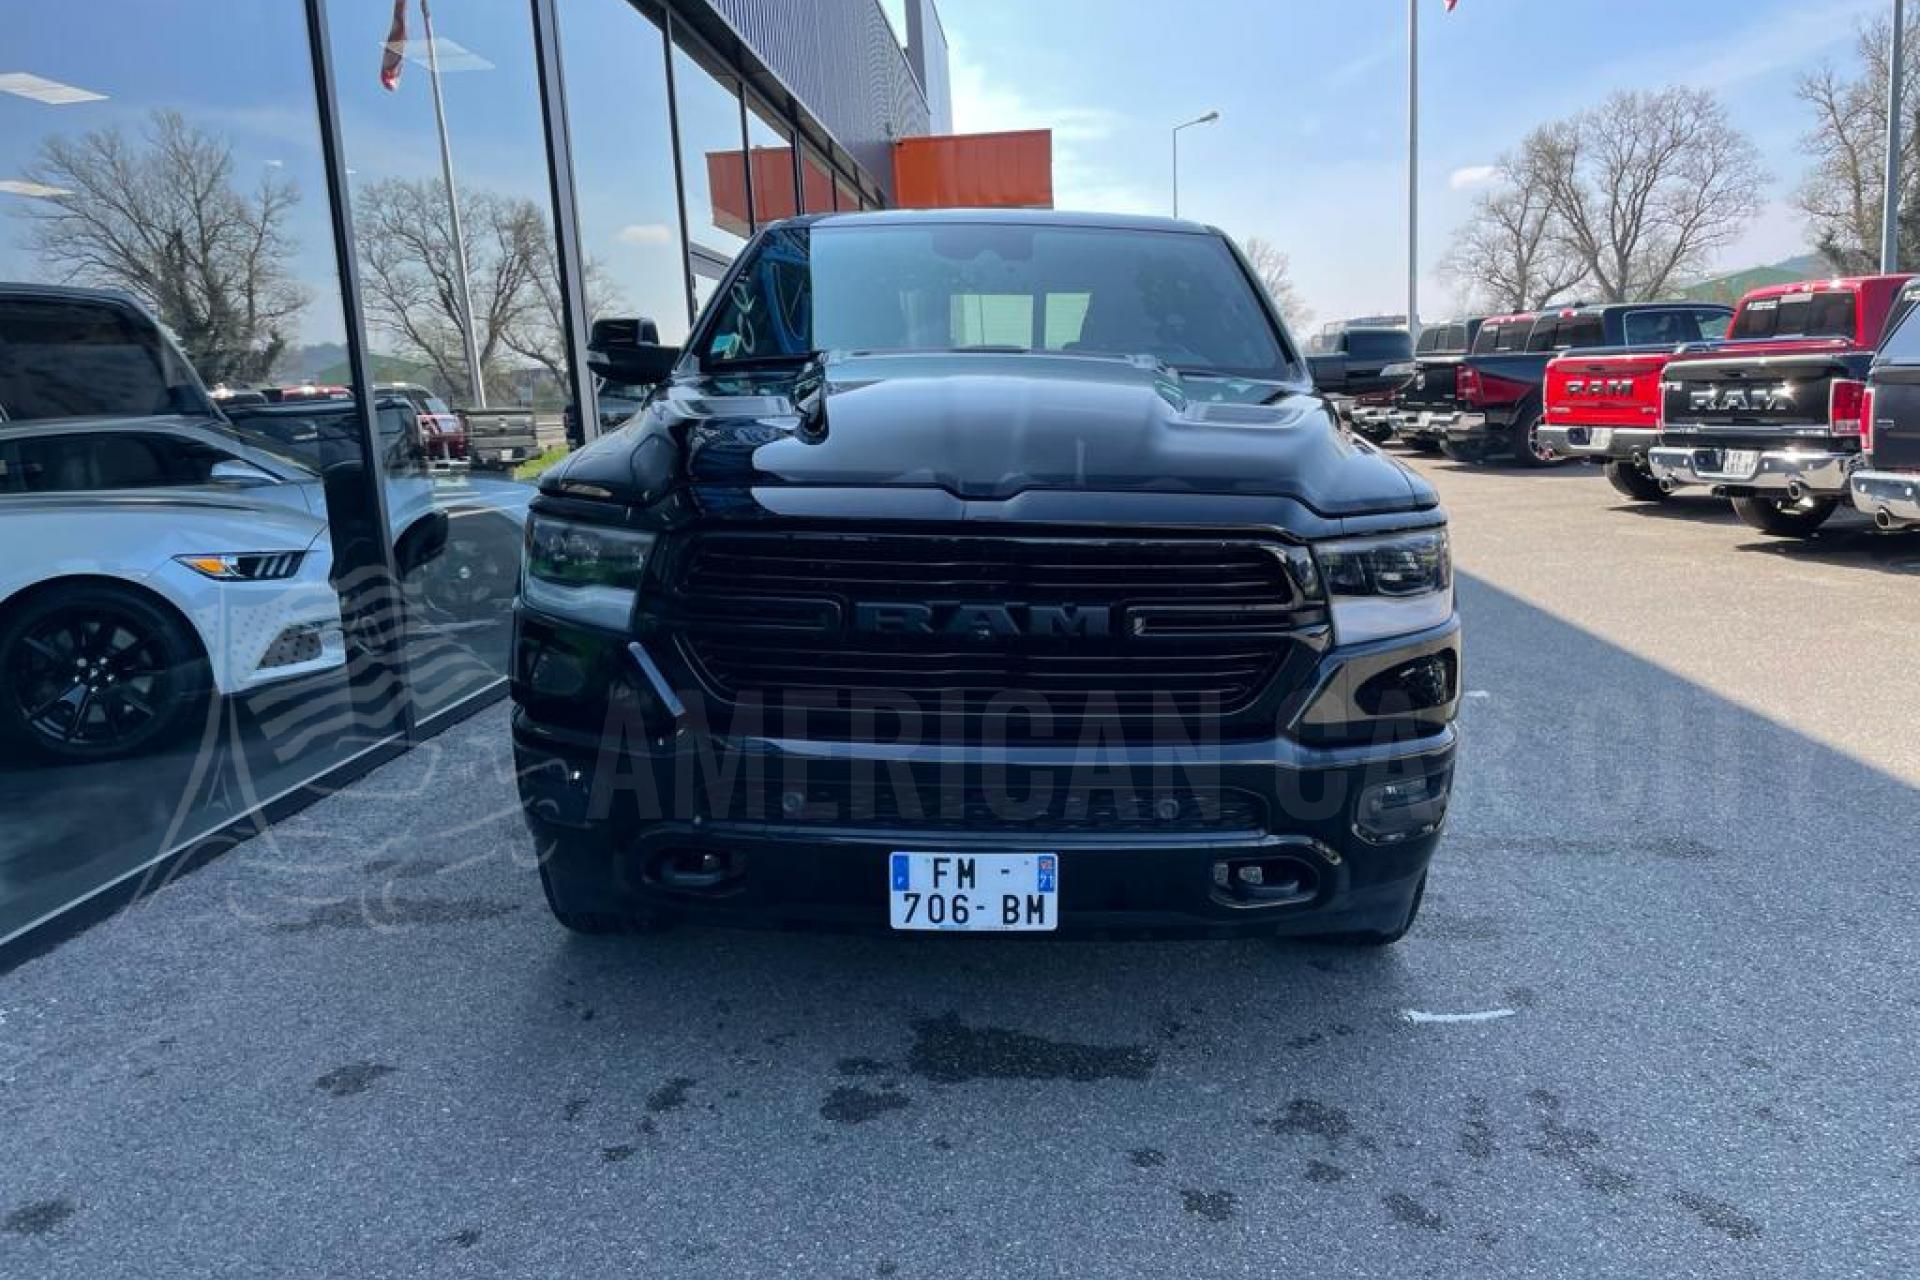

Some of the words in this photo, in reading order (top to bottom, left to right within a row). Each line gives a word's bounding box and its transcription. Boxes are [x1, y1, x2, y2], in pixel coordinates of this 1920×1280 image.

[1566, 380, 1633, 396] RAM
[1689, 384, 1793, 411] RAM
[854, 601, 1111, 637] RAM
[932, 857, 976, 889] FM
[1002, 894, 1045, 925] BM
